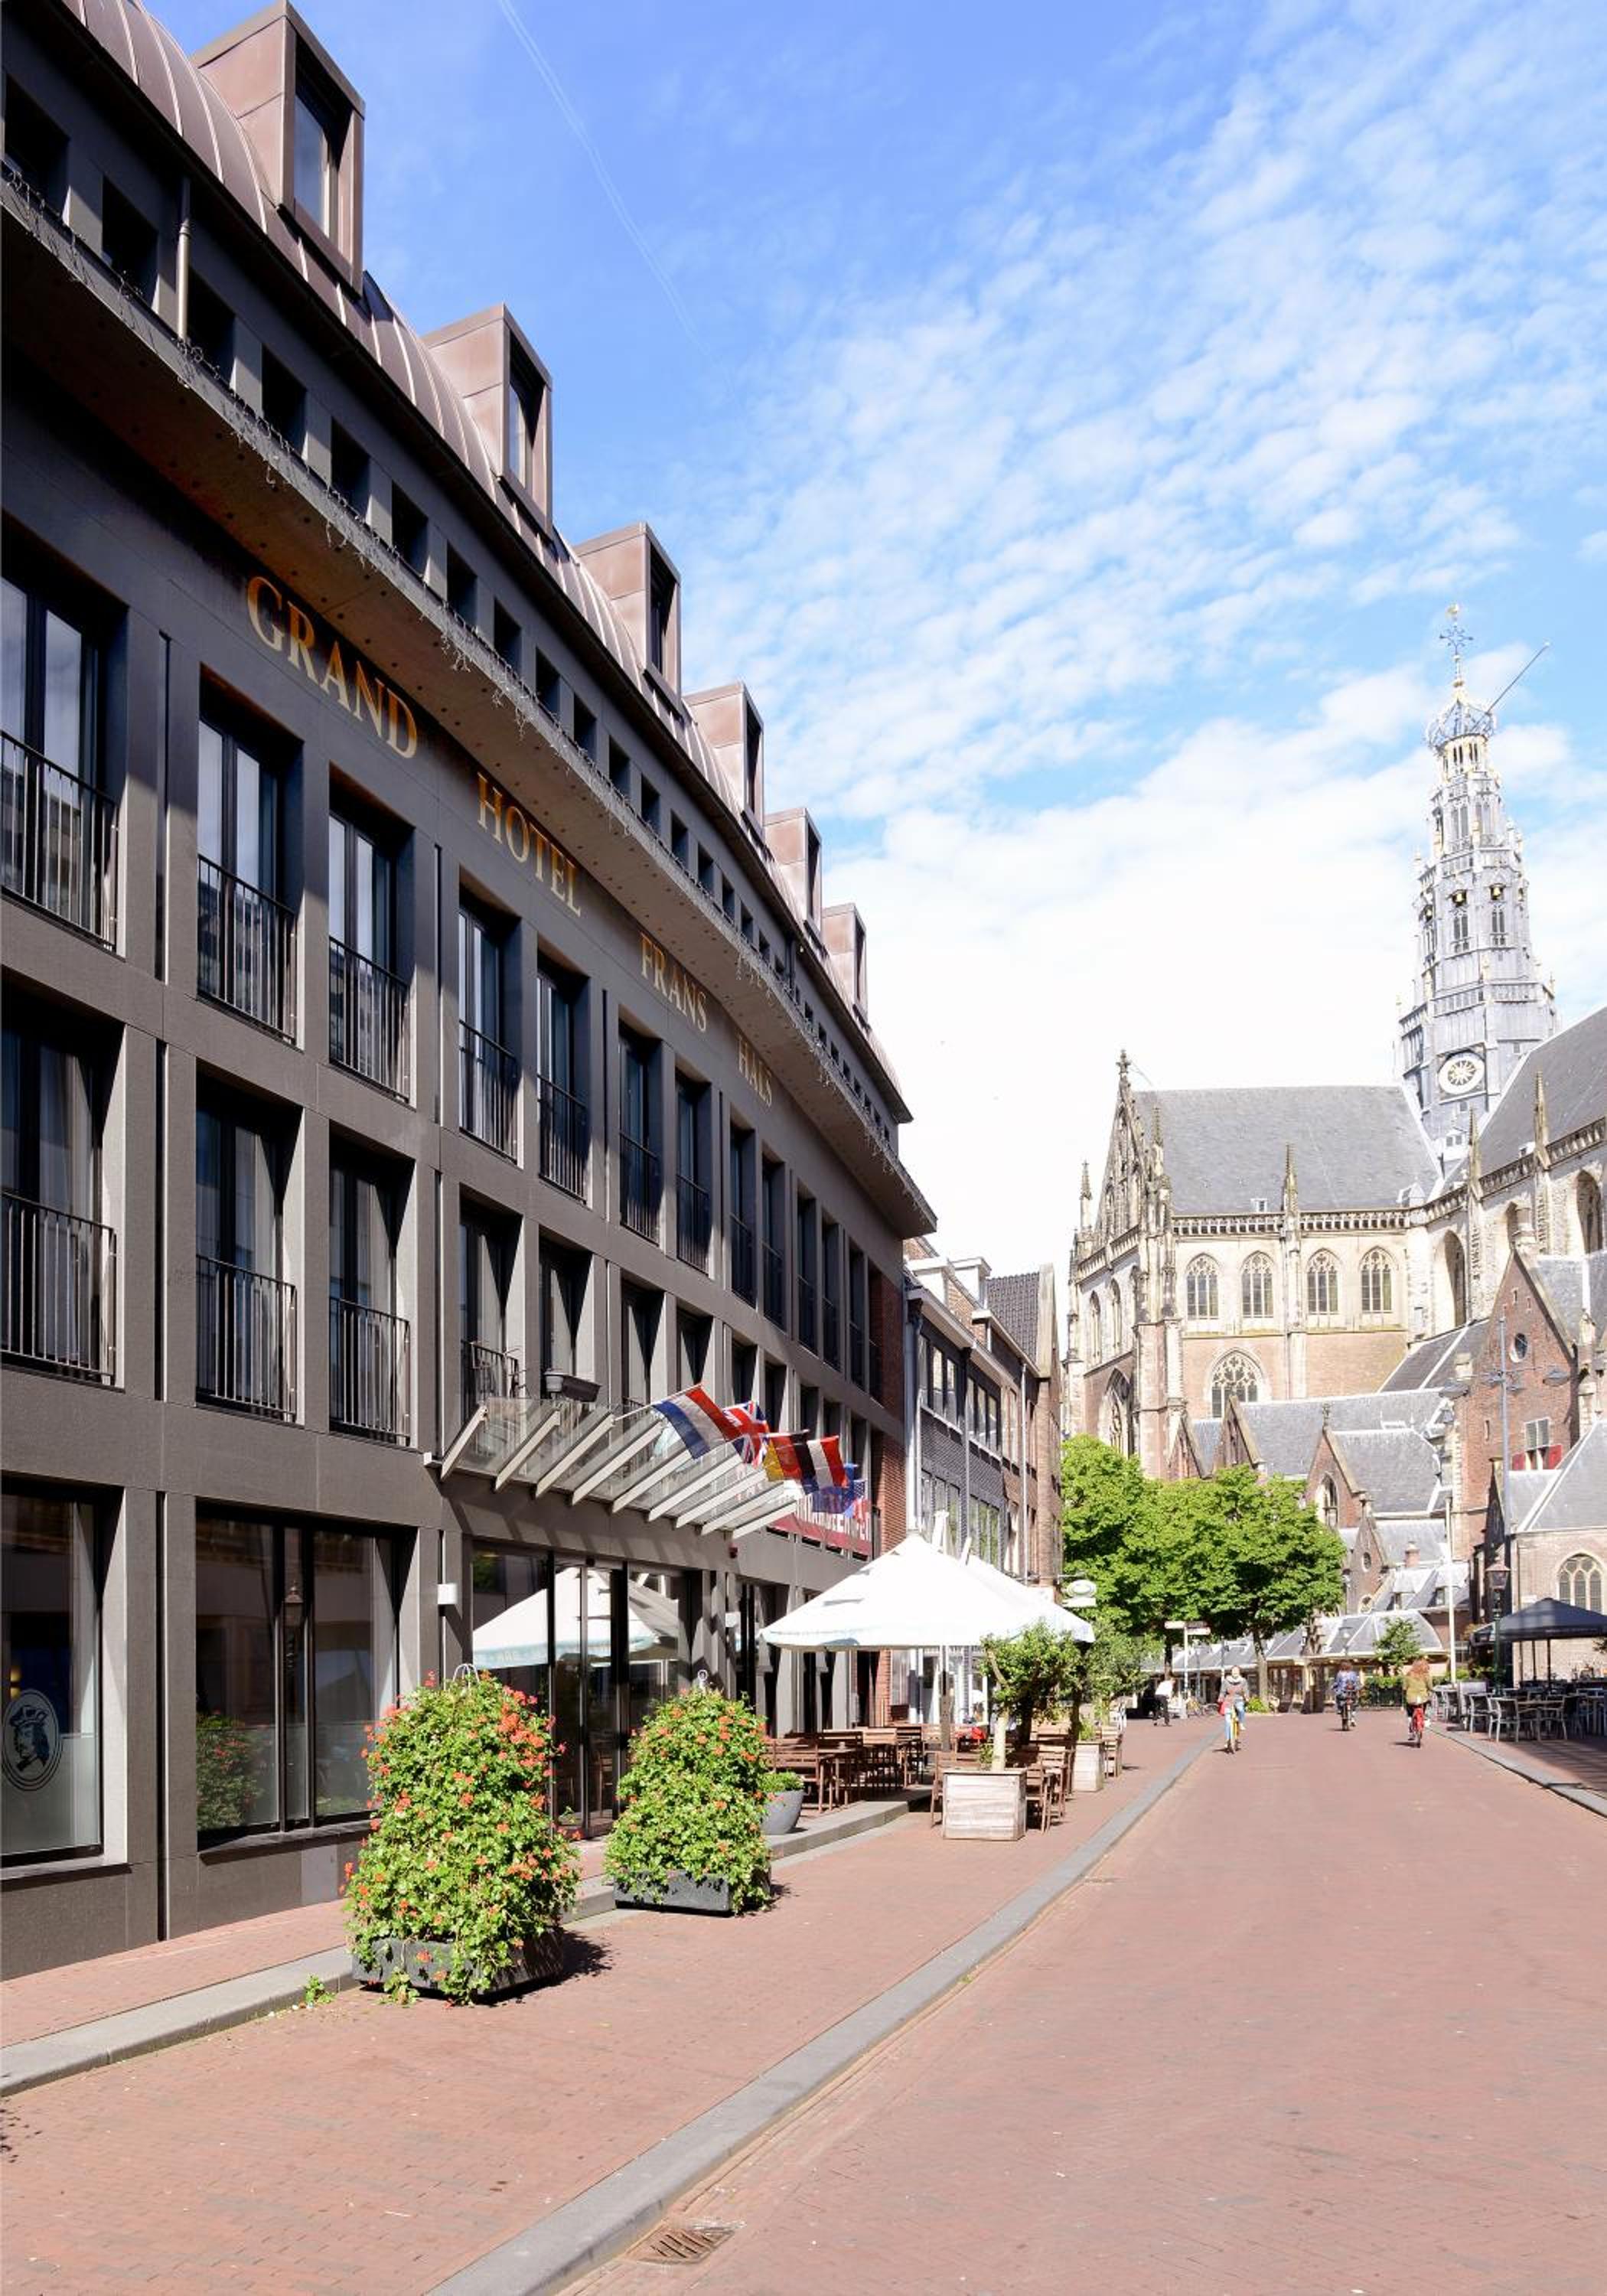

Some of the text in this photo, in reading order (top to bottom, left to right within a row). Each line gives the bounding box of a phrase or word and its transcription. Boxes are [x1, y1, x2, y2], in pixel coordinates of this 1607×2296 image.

[247, 576, 772, 1107] GRAND HOTEL FRANS HALS
